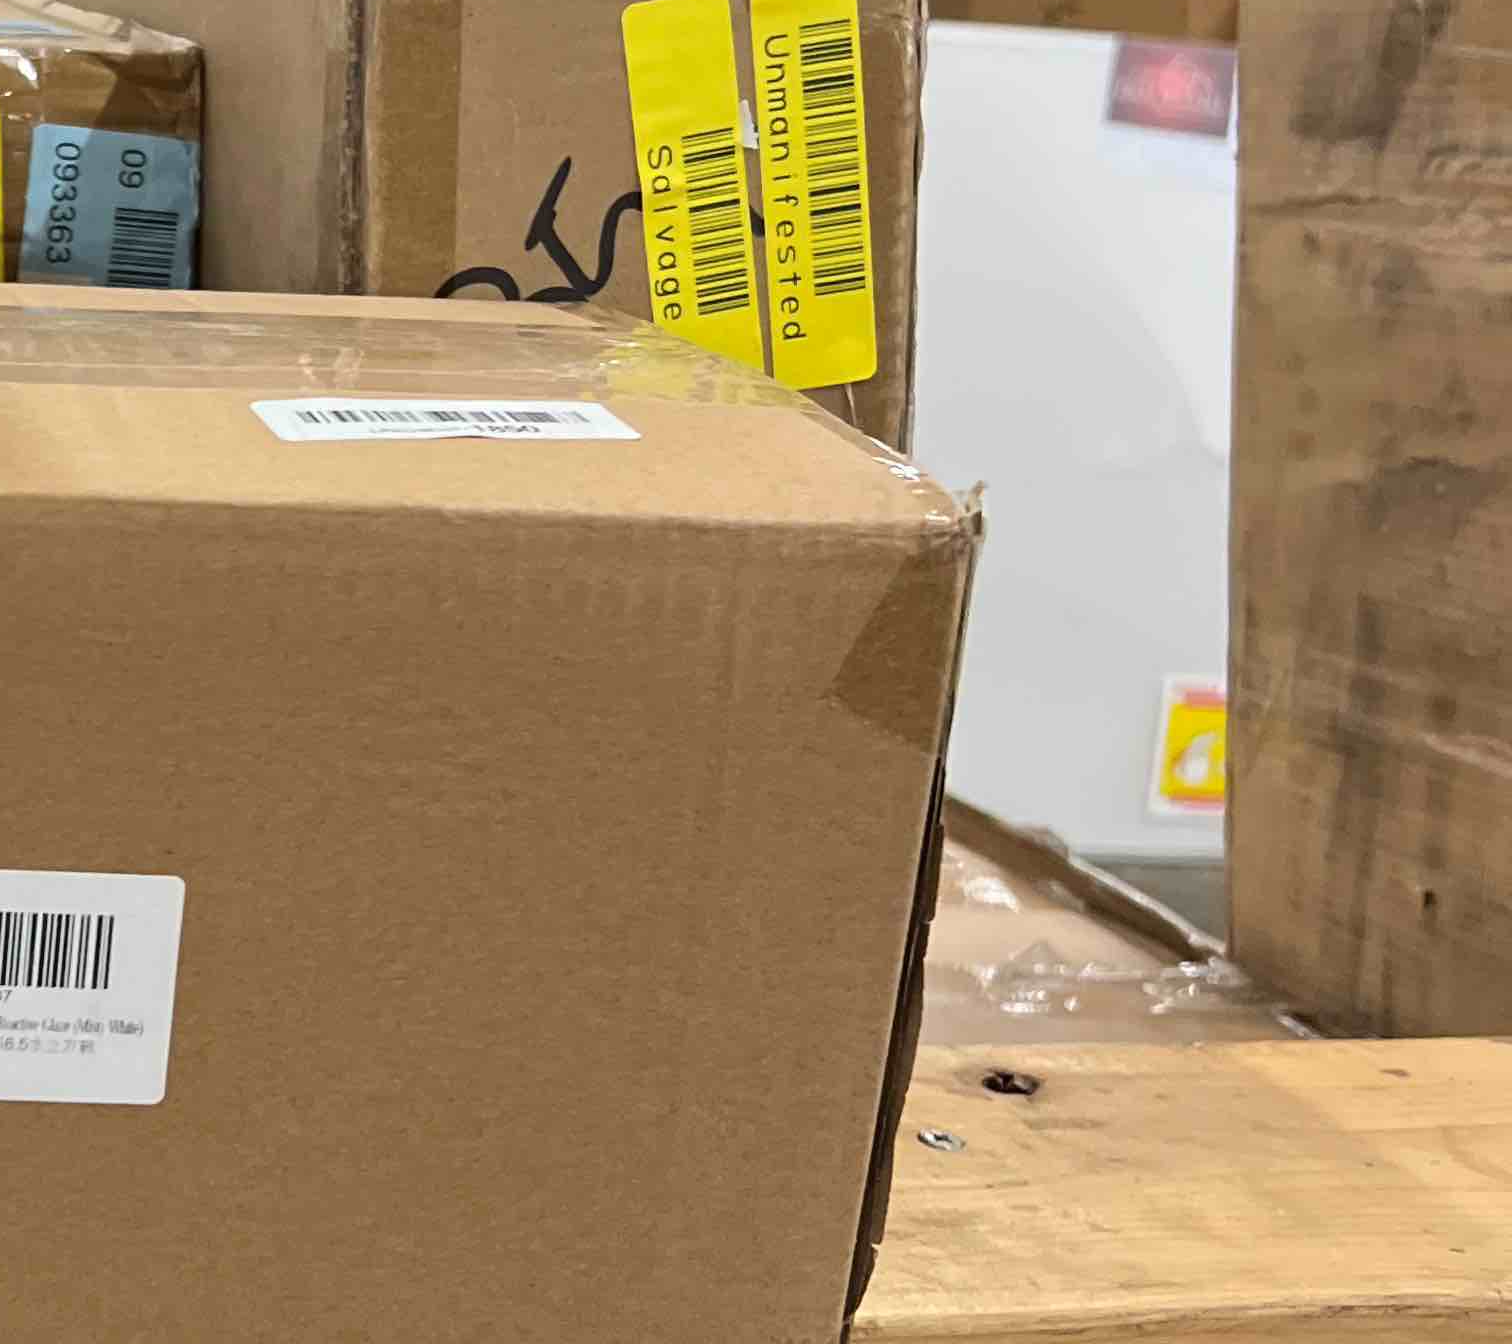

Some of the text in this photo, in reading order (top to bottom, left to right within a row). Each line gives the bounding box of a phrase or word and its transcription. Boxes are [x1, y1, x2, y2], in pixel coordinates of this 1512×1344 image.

[45, 141, 82, 265] 093363
[118, 149, 148, 190] 09
[646, 143, 684, 321] Salvage
[762, 33, 807, 341] Unmanifested
